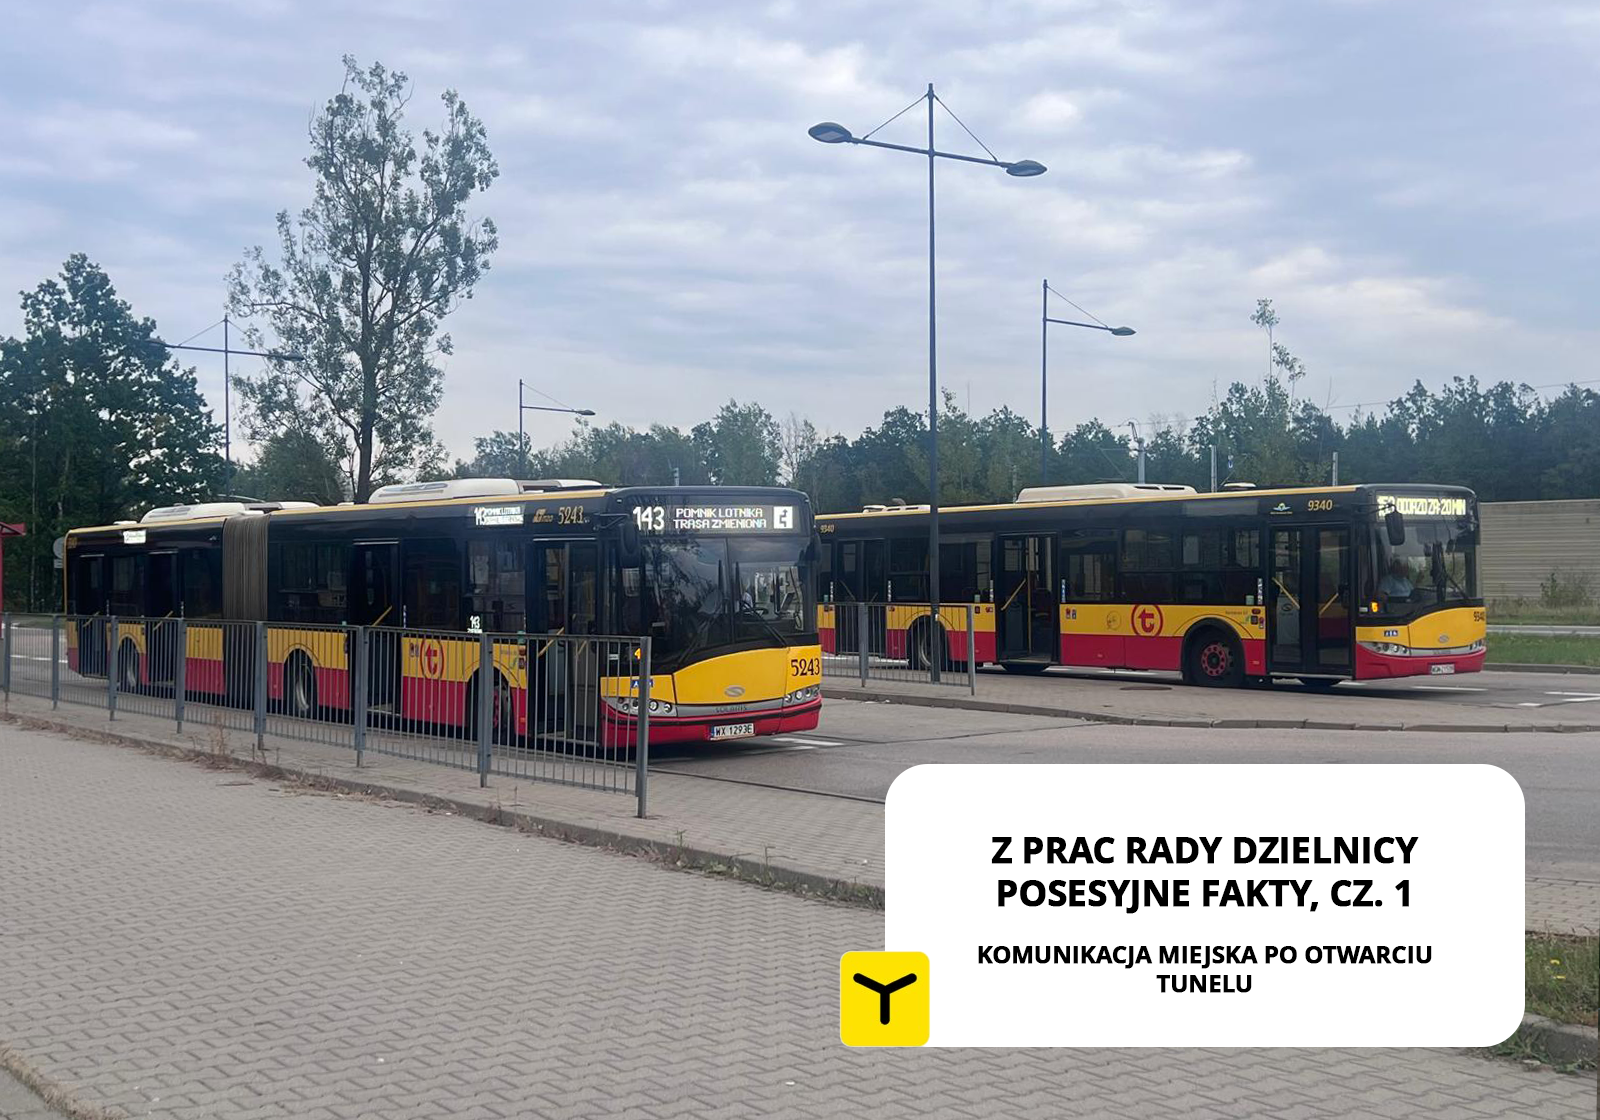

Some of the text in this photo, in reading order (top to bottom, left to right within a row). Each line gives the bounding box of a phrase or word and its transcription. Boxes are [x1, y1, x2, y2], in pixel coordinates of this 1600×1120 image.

[1308, 500, 1333, 511] 9340
[558, 505, 584, 524] 5243
[633, 506, 665, 531] 143
[676, 508, 763, 518] POMNIK LOTNIKA
[673, 518, 767, 529] TRASA ZMIENIONA
[791, 658, 820, 677] 5243
[715, 724, 753, 736] WX 1293E
